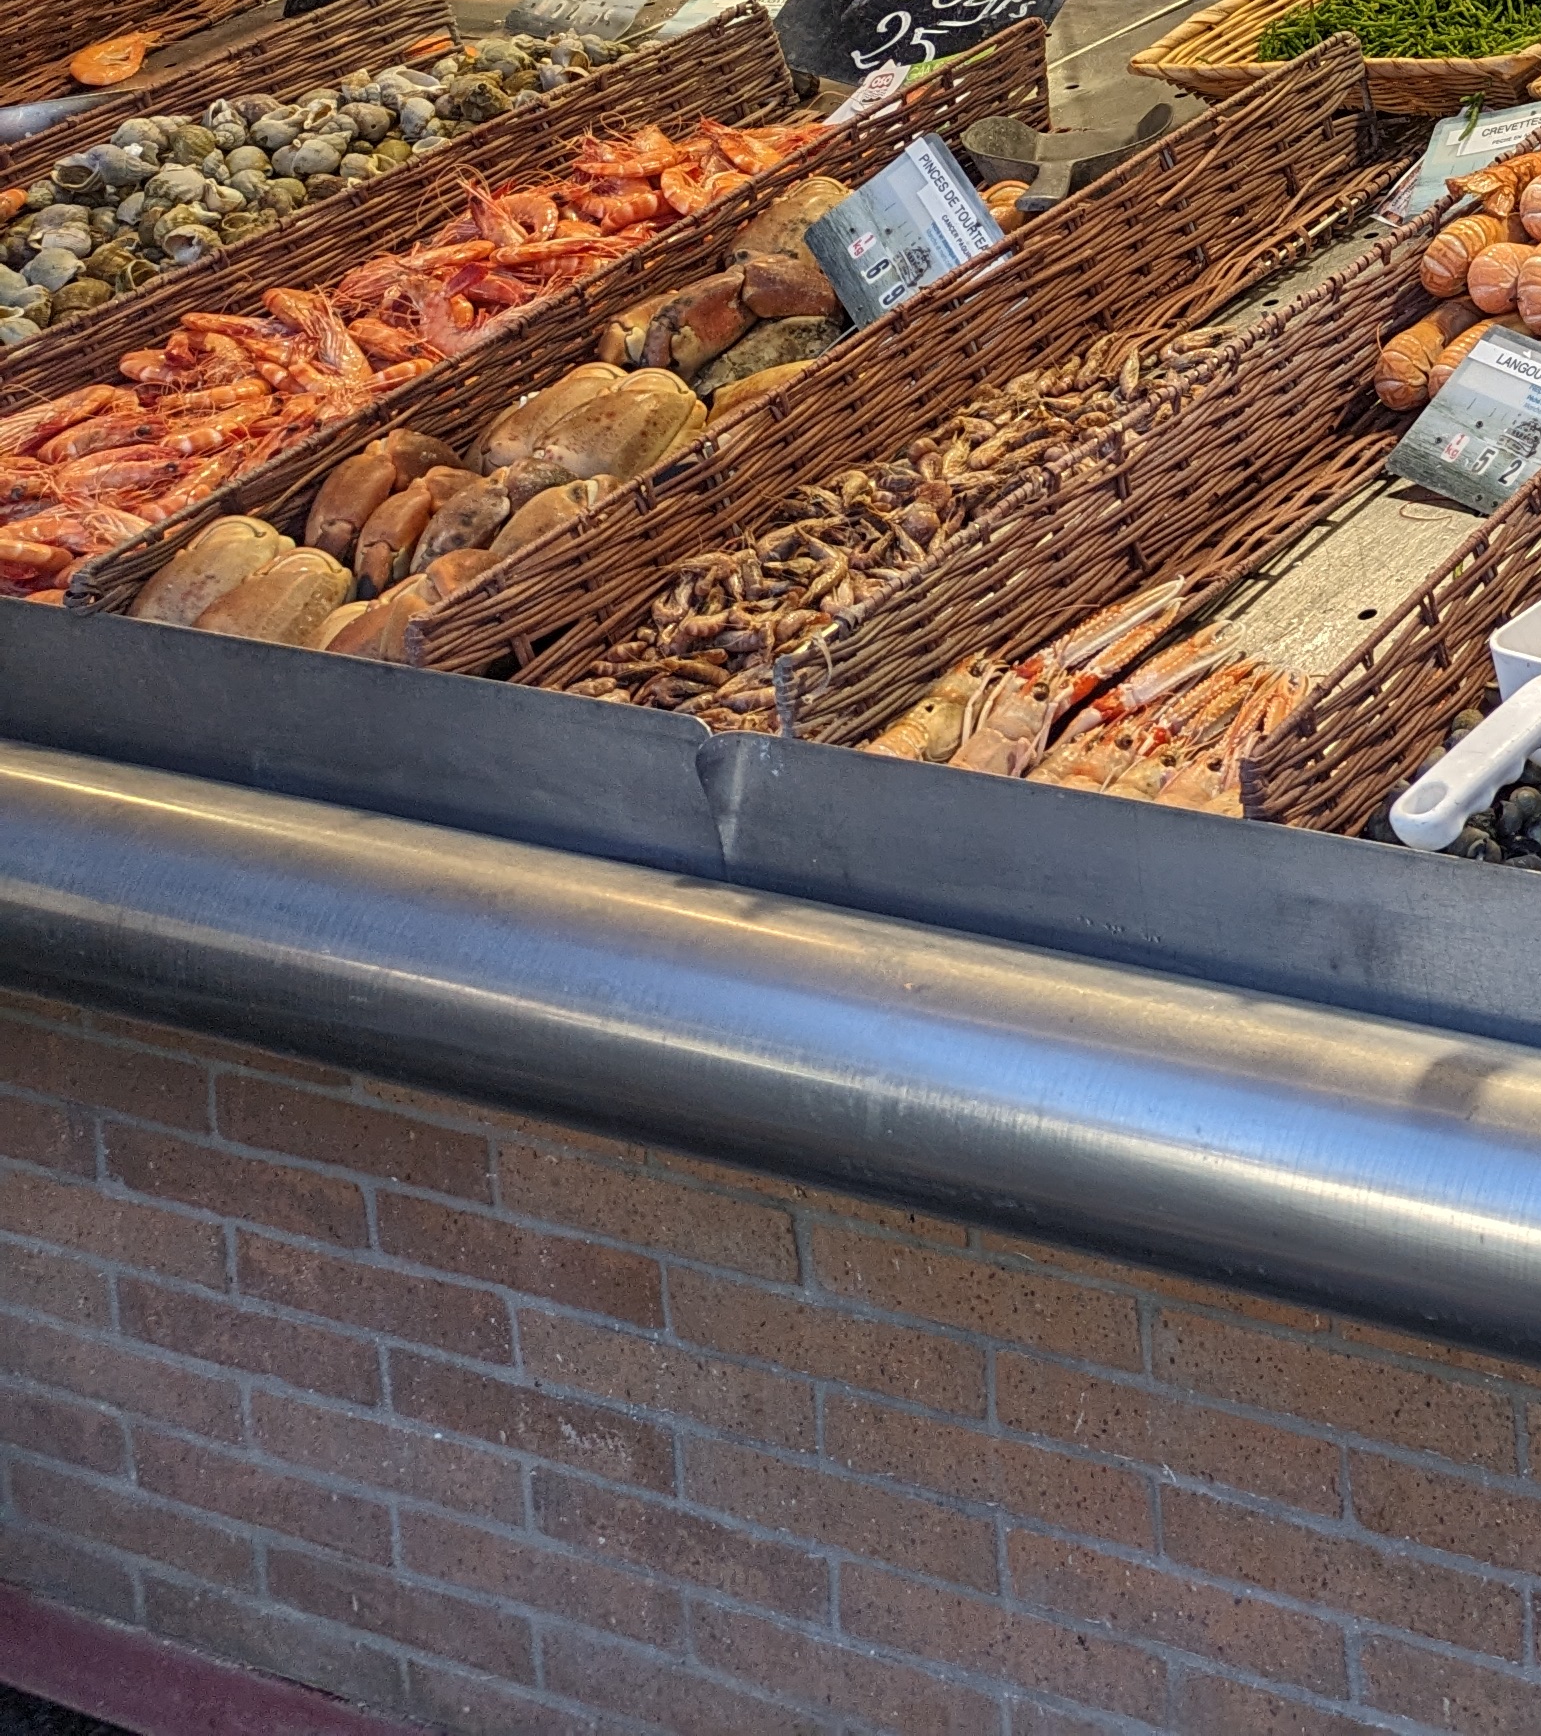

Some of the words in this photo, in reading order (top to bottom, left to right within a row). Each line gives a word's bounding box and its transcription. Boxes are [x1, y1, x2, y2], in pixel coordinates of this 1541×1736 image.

[918, 152, 951, 194] PINCES
[943, 188, 958, 209] DE
[941, 214, 958, 241] CANCER
